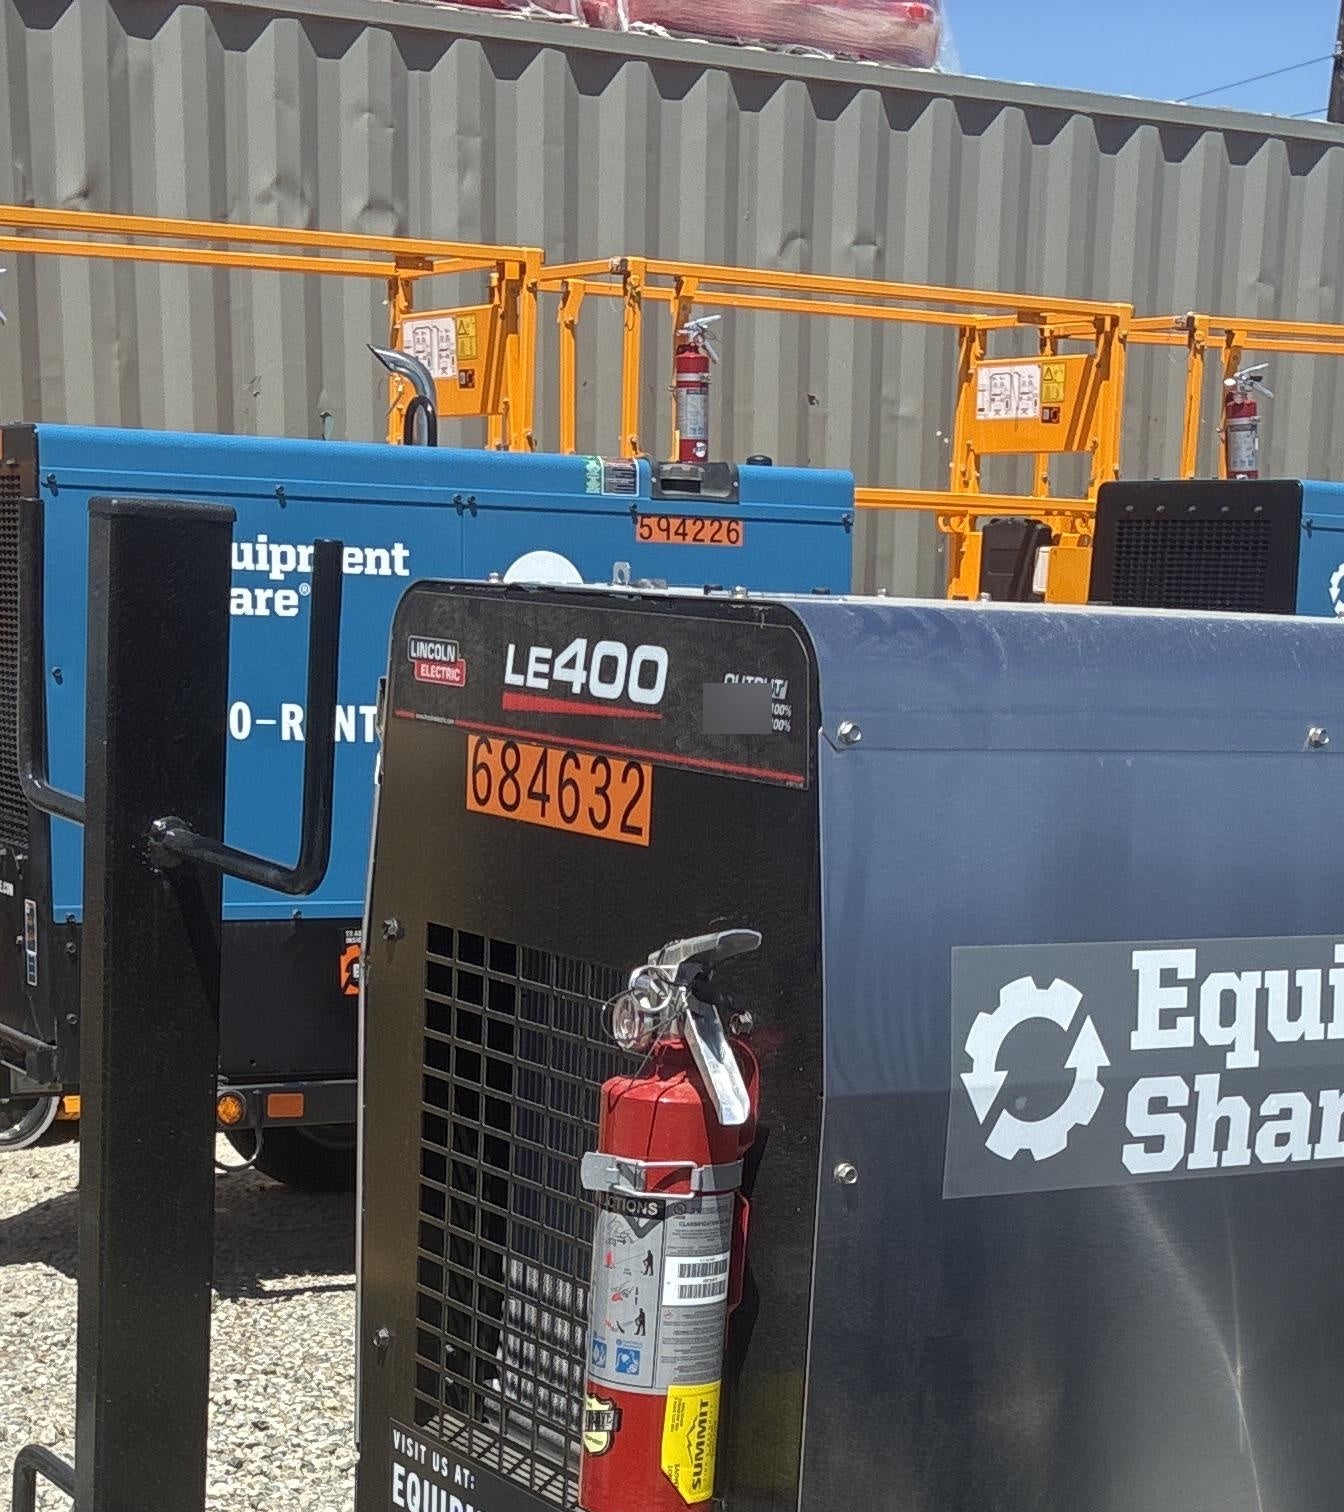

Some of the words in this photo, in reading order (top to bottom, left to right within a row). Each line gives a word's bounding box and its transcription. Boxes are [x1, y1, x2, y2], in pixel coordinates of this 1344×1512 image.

[638, 516, 742, 546] 594226
[231, 534, 410, 581] uipent
[230, 587, 299, 617] are
[410, 639, 456, 662] LINCOLN
[421, 664, 461, 682] ELECTRIC
[505, 638, 668, 704] LE400
[471, 735, 645, 836] 684632
[392, 1428, 427, 1465] VISIT
[432, 1451, 449, 1478] US
[454, 1464, 476, 1490] AT:
[691, 1399, 709, 1490] SUMMIT
